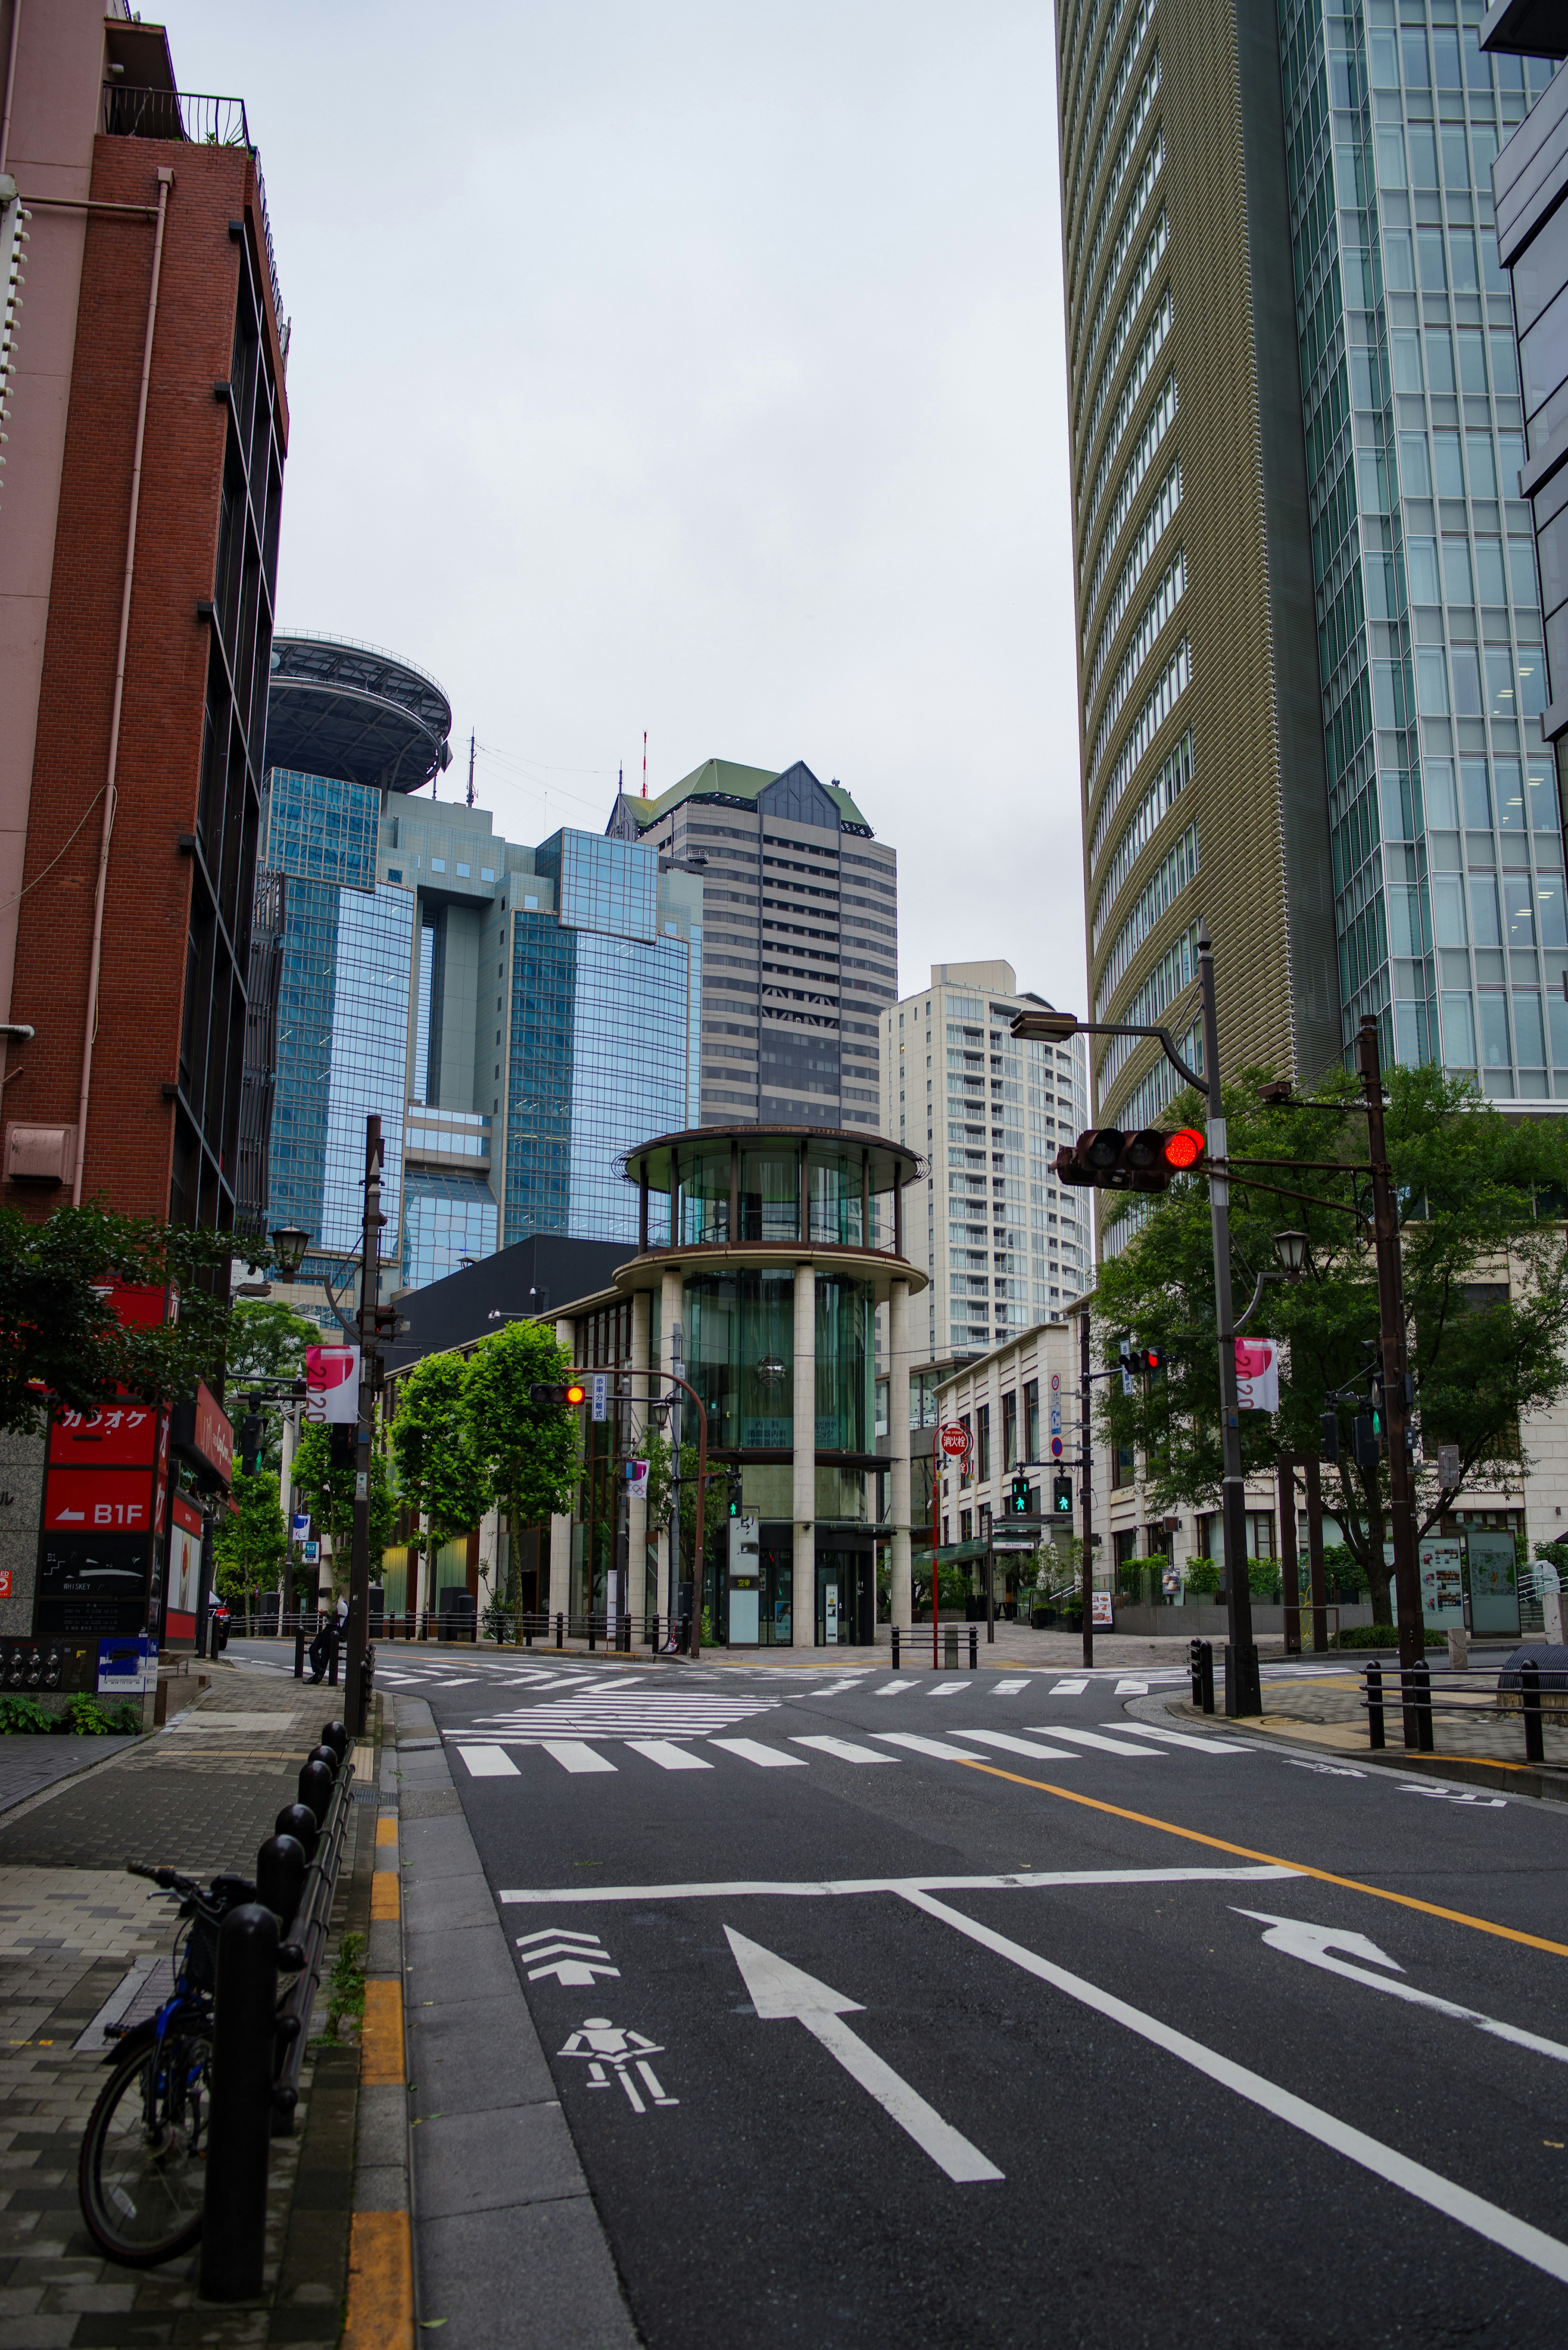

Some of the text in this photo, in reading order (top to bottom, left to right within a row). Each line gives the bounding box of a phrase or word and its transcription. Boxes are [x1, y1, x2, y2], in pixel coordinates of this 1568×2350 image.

[1235, 1356, 1254, 1410] 2020
[306, 1366, 327, 1423] 2020
[595, 1378, 604, 1418] 歩車分離式
[62, 1410, 147, 1429] カラオケ
[748, 1429, 786, 1438] 循環器内科
[943, 1436, 966, 1447] 消火栓
[94, 1504, 143, 1524] B1F
[47, 1553, 56, 1562] B1
